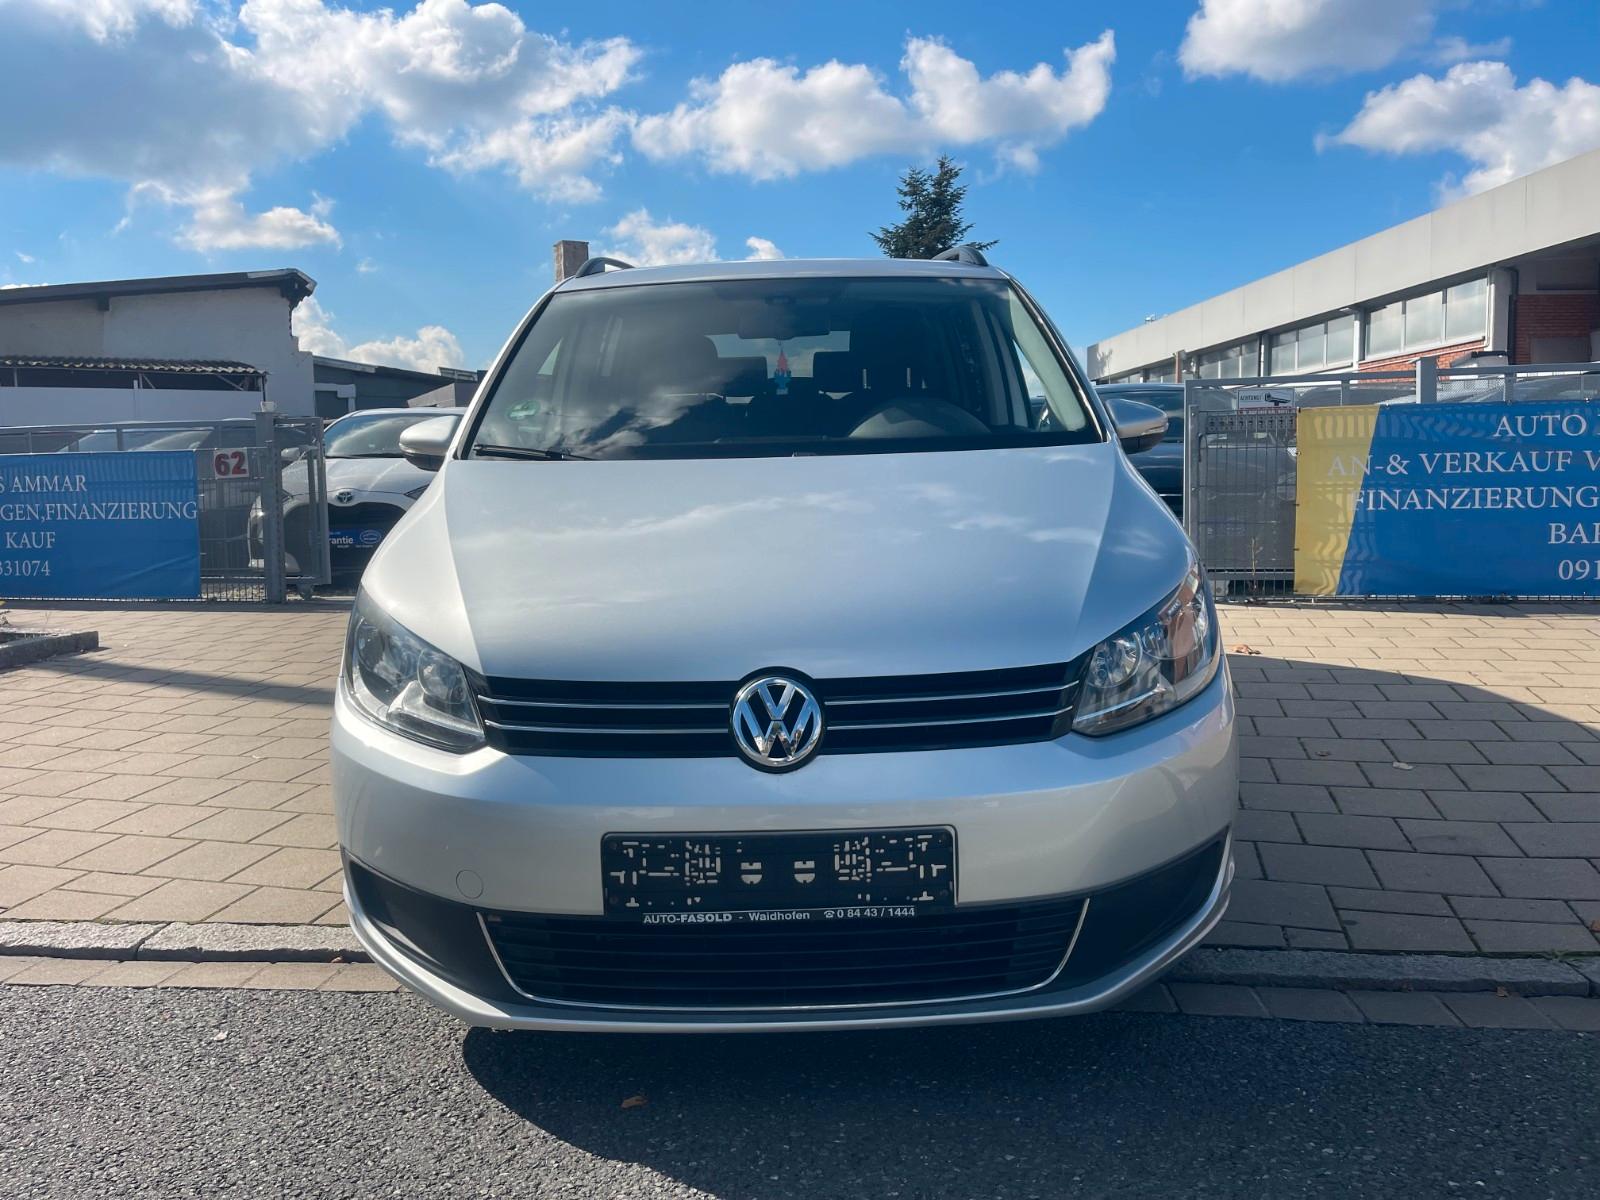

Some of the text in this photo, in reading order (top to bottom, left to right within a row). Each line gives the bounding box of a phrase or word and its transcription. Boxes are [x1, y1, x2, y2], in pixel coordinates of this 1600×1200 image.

[1493, 414, 1587, 437] AUTO
[214, 451, 248, 477] 62
[1418, 450, 1573, 475] VERKAUF
[10, 474, 88, 493] AMMAR
[1352, 485, 1599, 511] FINANZIERUNG
[0, 501, 198, 523] GEN,FINANZIERUNG
[5, 531, 57, 549] KAUF
[643, 913, 733, 925] AUTO-FASOLD
[749, 910, 811, 923] Waidhofen
[847, 908, 861, 918] 84
[863, 907, 878, 918] 43
[888, 906, 916, 917] 1444
